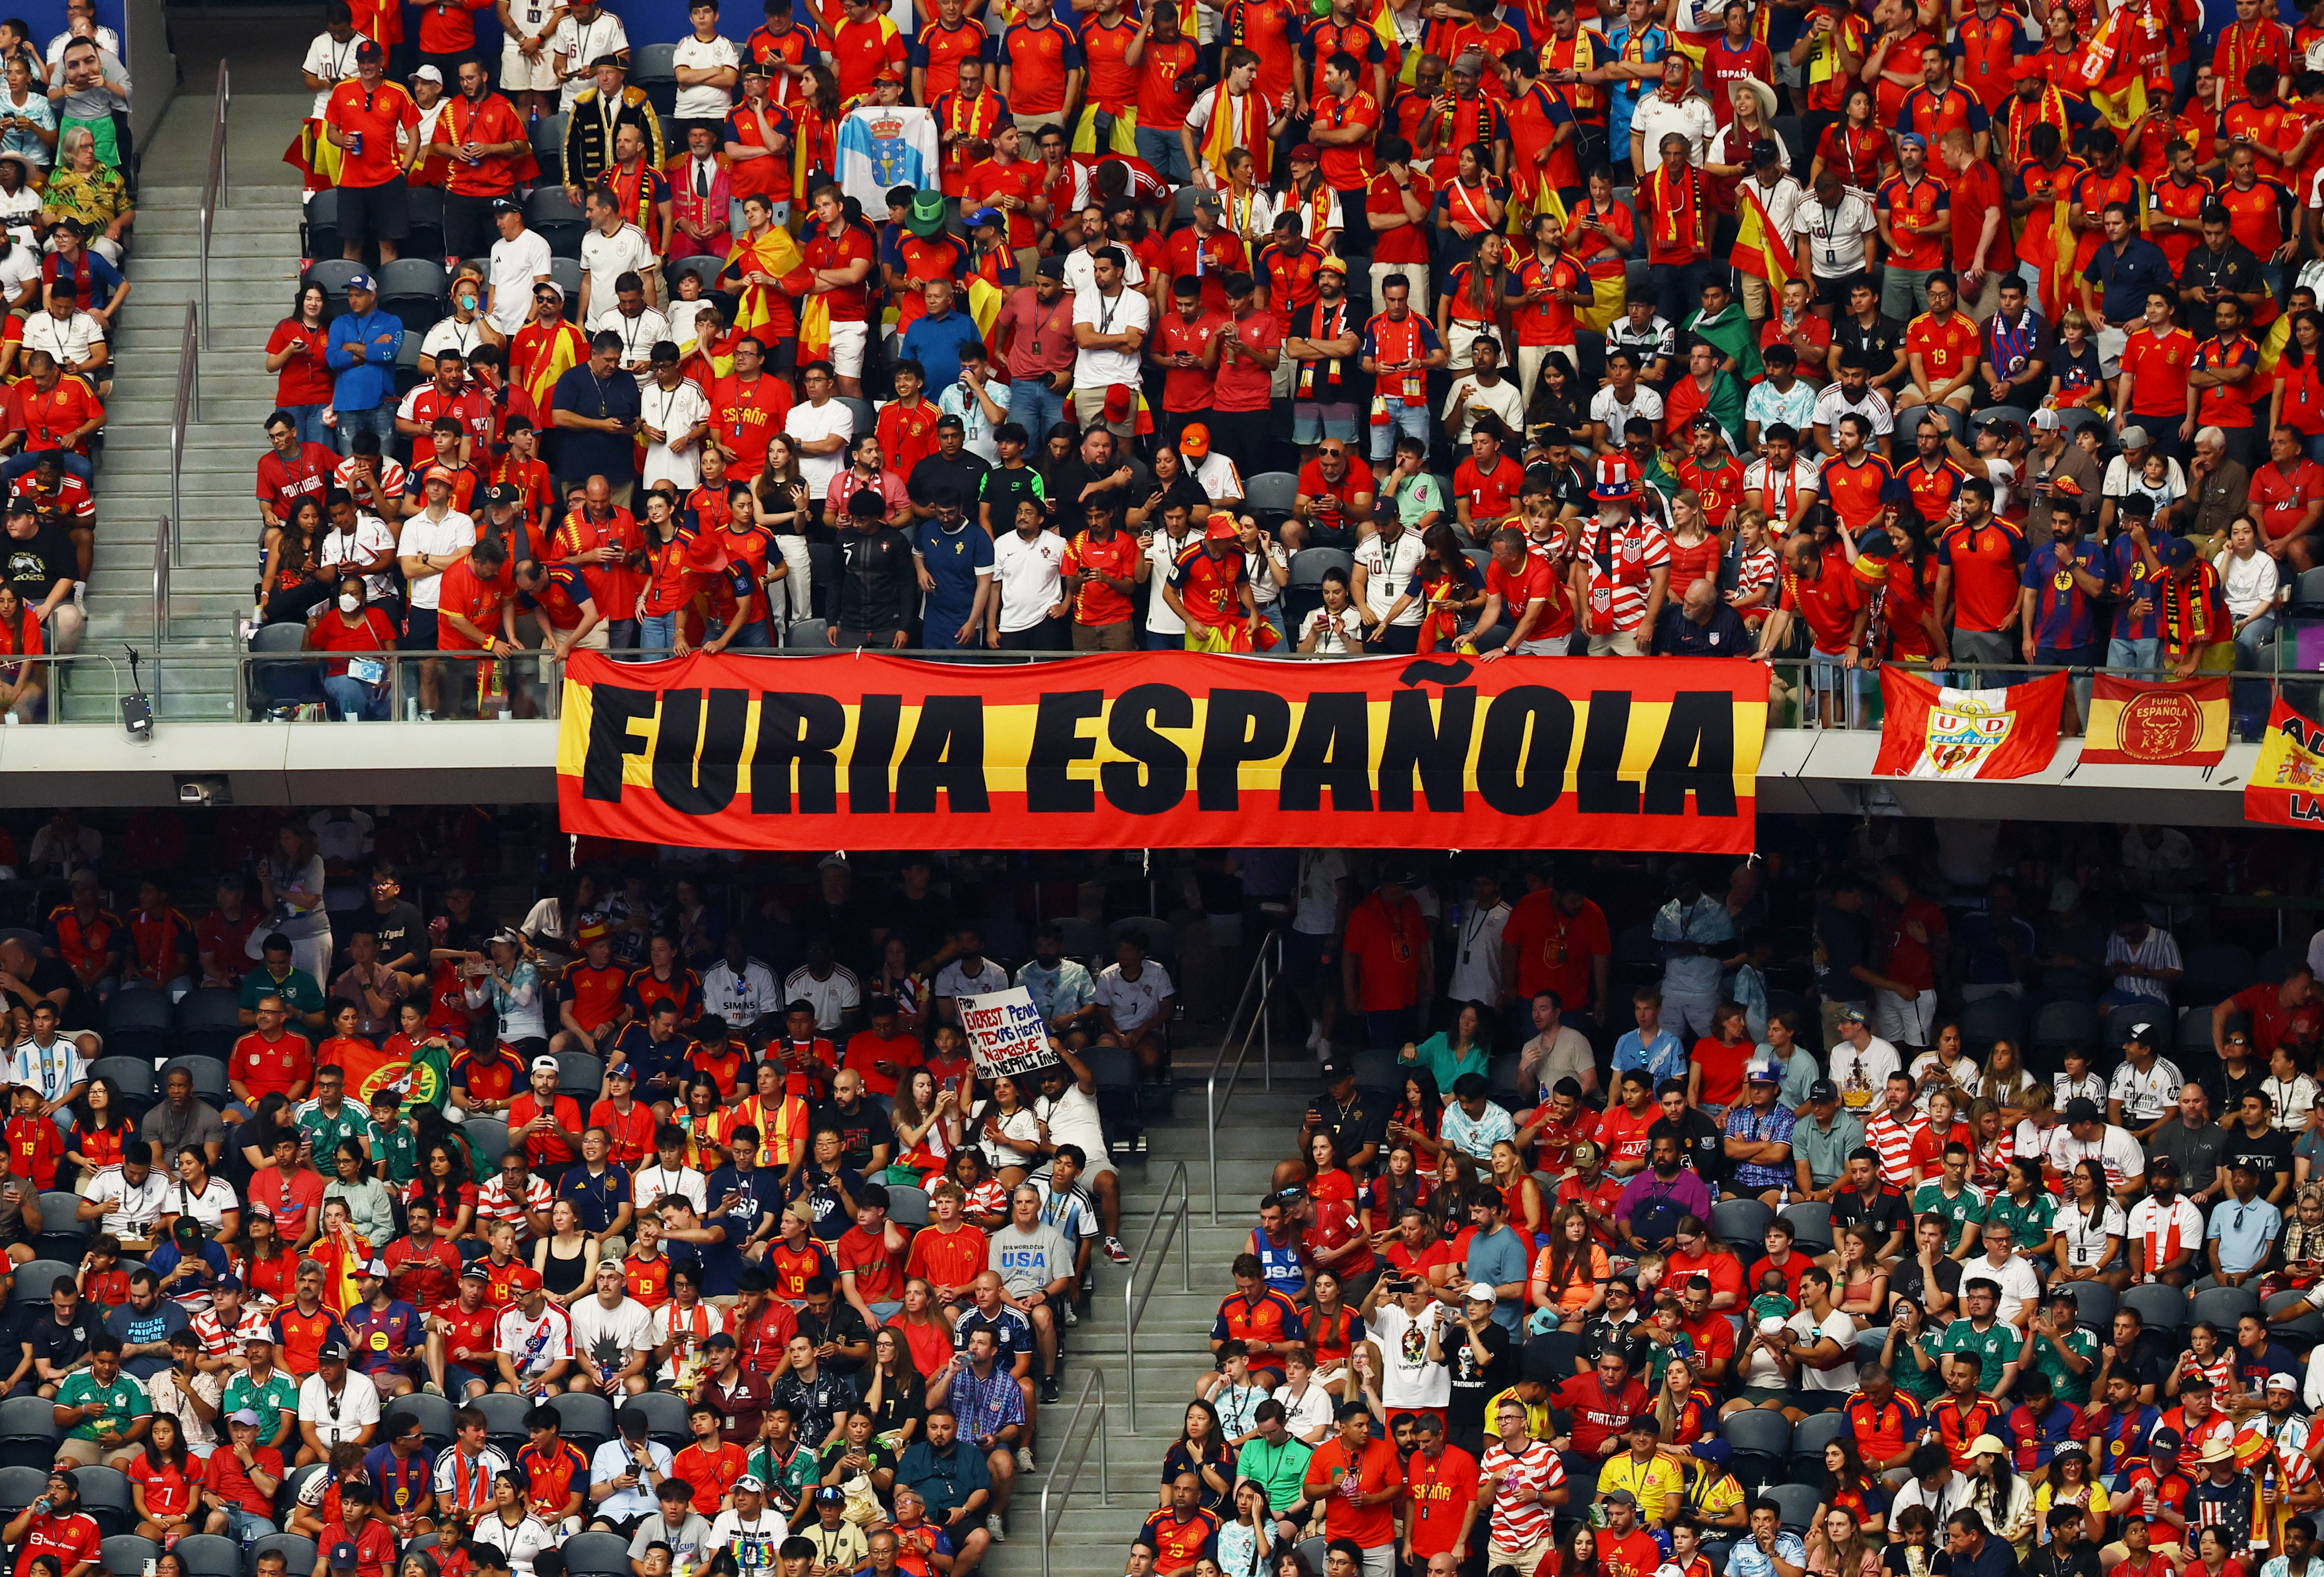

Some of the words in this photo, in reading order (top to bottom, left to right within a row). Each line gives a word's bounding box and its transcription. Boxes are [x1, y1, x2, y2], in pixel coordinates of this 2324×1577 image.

[567, 44, 580, 59] 16
[1159, 62, 1176, 78] 77
[1717, 68, 1754, 79] ESPAÑA
[1906, 214, 1919, 228] 16
[1812, 227, 1827, 238] 10
[1932, 349, 1947, 365] 19
[2139, 346, 2146, 360] 7
[723, 407, 768, 427] ESPAÑA
[1473, 489, 1481, 504] 7
[1704, 492, 1714, 507] 17
[1624, 539, 1640, 548] USA
[843, 549, 851, 565] 7
[1370, 559, 1382, 574] 10
[1594, 589, 1608, 600] USA
[2137, 705, 2188, 718] ESPAÑOLA
[1939, 716, 1956, 729] U
[1986, 720, 2004, 732] D
[582, 682, 991, 816] FURIA
[1026, 658, 1738, 817] ESPAÑOLA
[1895, 932, 1900, 946] 7
[958, 997, 976, 1010] FROM
[1131, 1003, 1138, 1015] 7
[964, 1007, 1003, 1030] EVEREST
[1006, 1002, 1037, 1023] PEAK
[1047, 1005, 1054, 1021] 7
[977, 1027, 1015, 1047] TEXAS
[1014, 1019, 1043, 1038] HEAT
[976, 1063, 994, 1079] FROM
[992, 1053, 1038, 1076] NEPALI
[1333, 1125, 1341, 1134] 7
[22, 1141, 35, 1156] 19
[1846, 1216, 1855, 1227] 11
[1002, 1252, 1045, 1268] USA
[495, 1283, 508, 1300] 19
[640, 1279, 652, 1294] 19
[790, 1276, 804, 1293] 19
[151, 1332, 163, 1340] ME
[889, 1399, 895, 1418] 7
[2156, 1439, 2172, 1450] Modelo
[164, 1488, 173, 1507] 7
